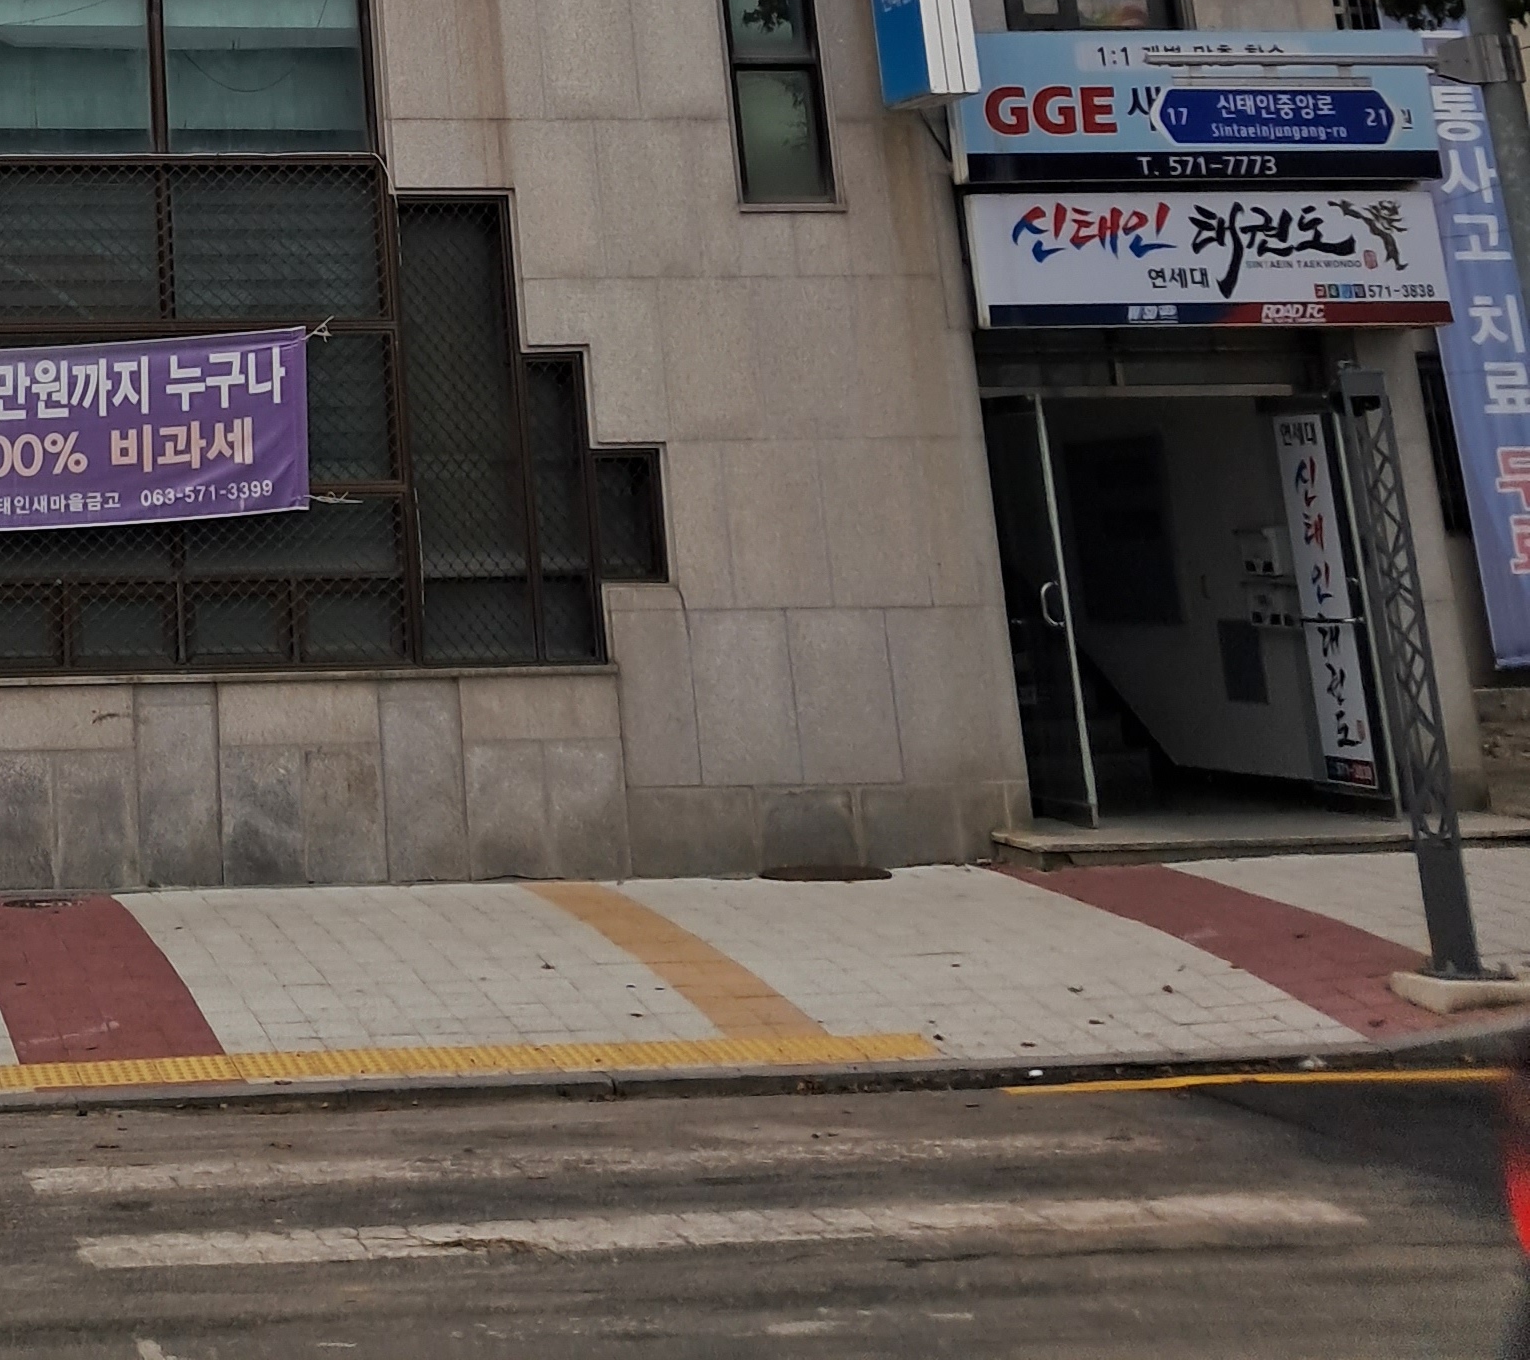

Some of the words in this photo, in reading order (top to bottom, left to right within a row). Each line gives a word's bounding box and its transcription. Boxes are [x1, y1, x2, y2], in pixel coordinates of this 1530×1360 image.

[1097, 46, 1131, 67] 1:1
[985, 85, 1118, 136] GGE
[1167, 108, 1189, 126] 17
[1217, 93, 1337, 120] 신태인중앙로
[1366, 108, 1389, 128] 21
[1212, 122, 1348, 141] Sintaeinjungang-ro
[1422, 30, 1500, 263] 통사고
[1137, 155, 1160, 176] T.
[1170, 155, 1277, 177] 571-7773
[1011, 201, 1177, 263] 신태인
[1188, 201, 1355, 299] 태권도
[1148, 267, 1210, 290] 연세대
[1368, 283, 1436, 299] 571-3838
[1261, 304, 1303, 319] ROAD
[165, 345, 286, 413] 누구나
[111, 416, 254, 473] 비과세
[140, 480, 273, 508] 063-571-3399
